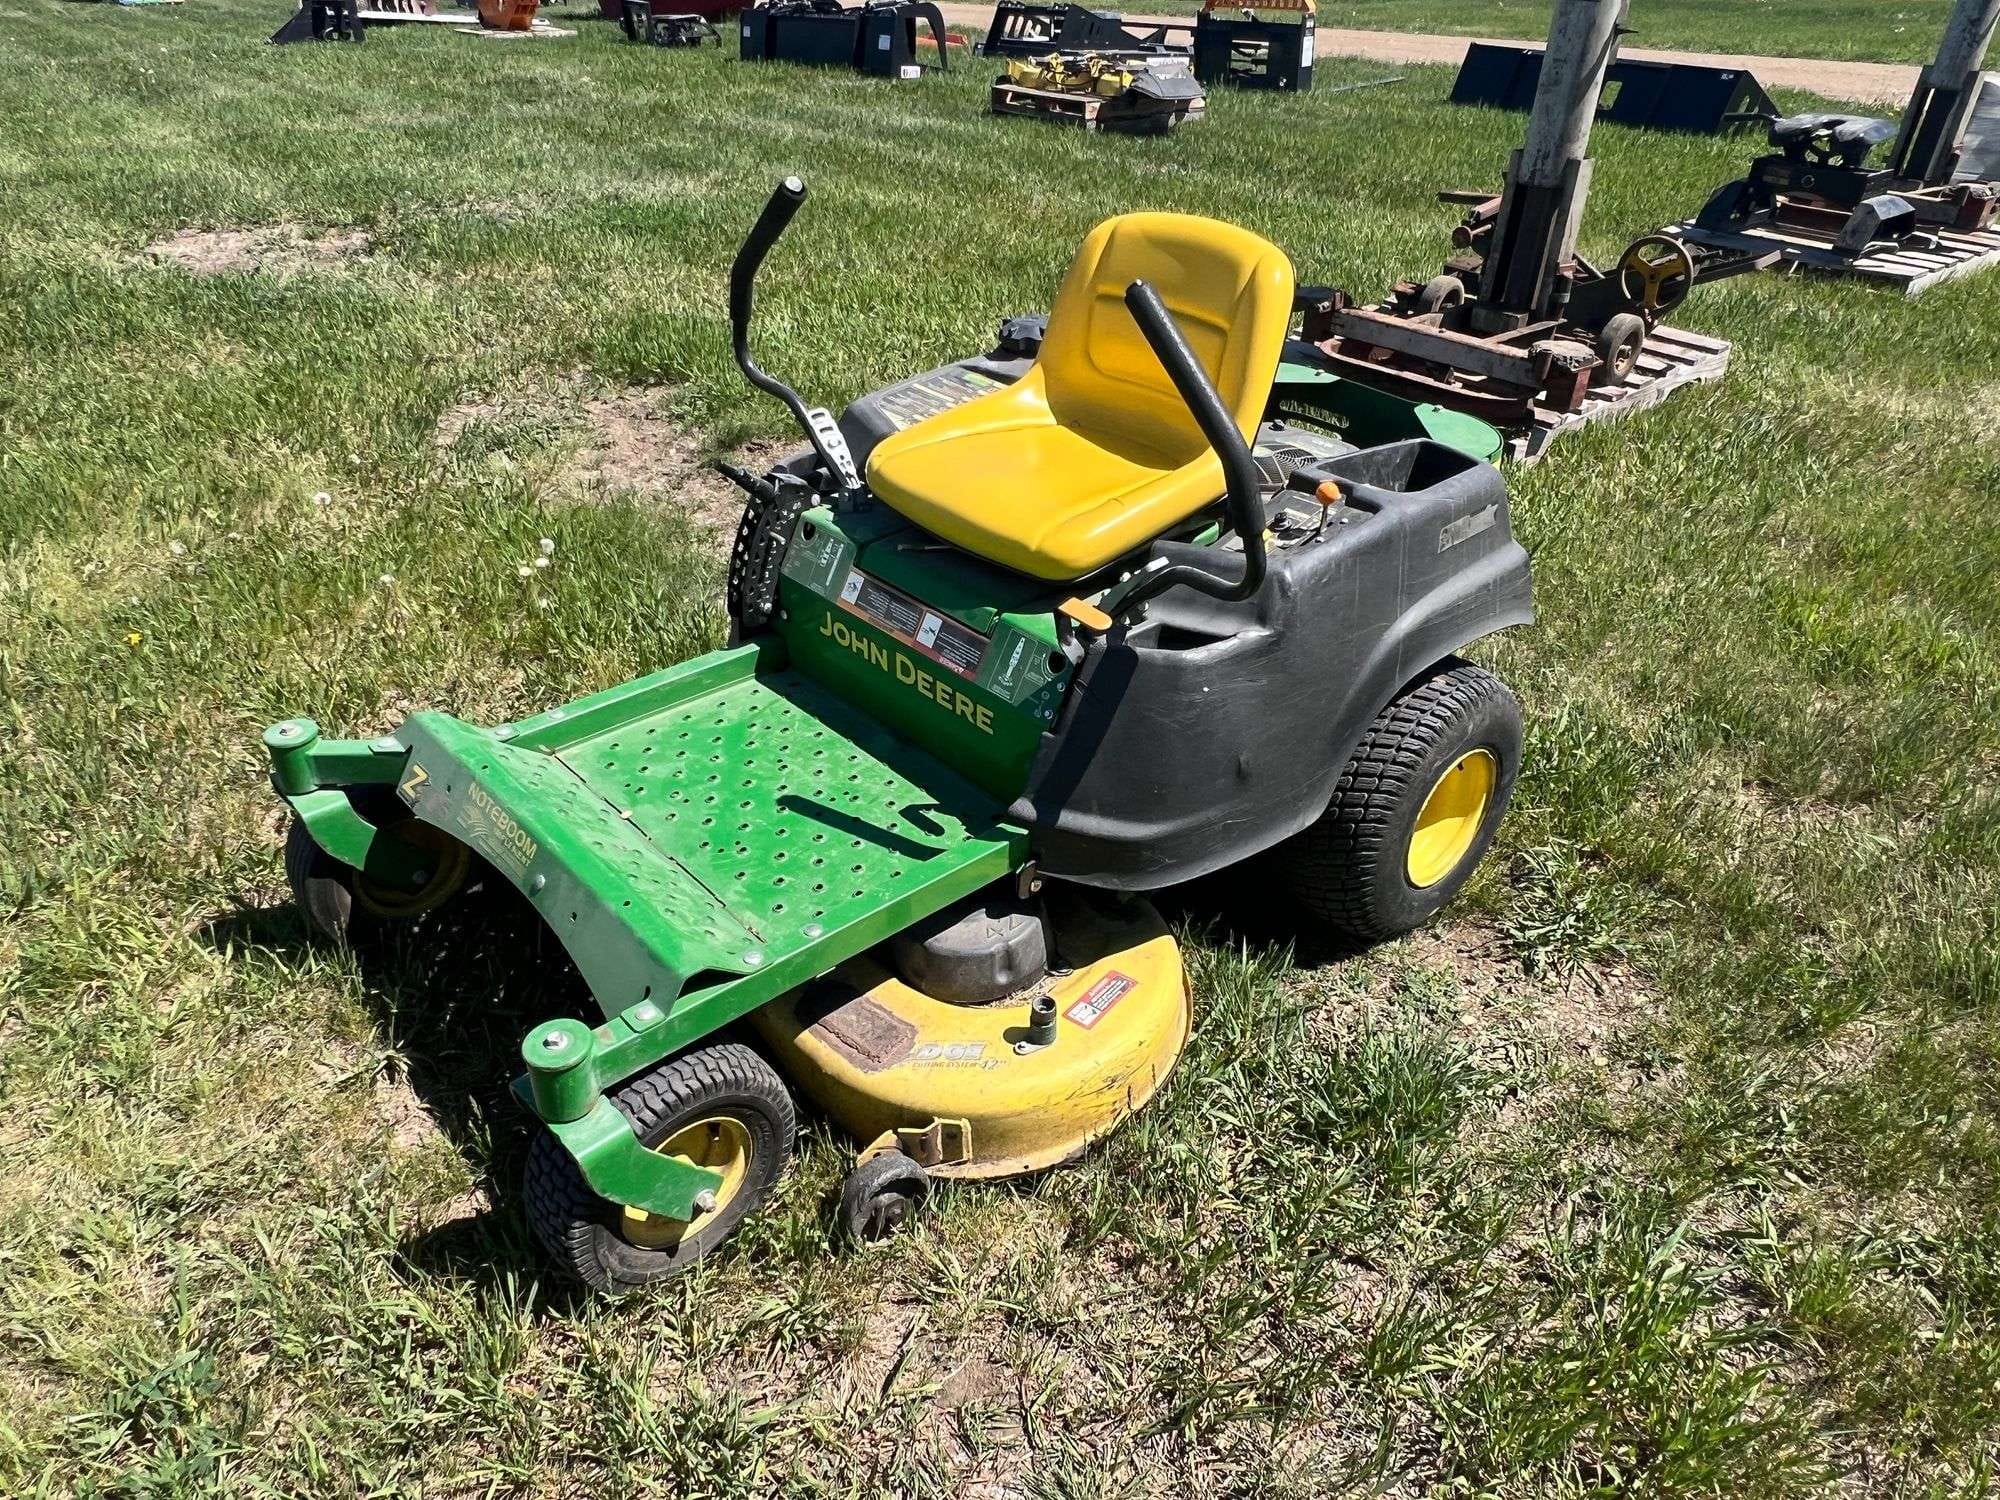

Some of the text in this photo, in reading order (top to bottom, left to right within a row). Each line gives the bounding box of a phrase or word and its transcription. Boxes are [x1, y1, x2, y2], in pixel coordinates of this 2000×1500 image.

[819, 611, 889, 672] JOHN
[895, 652, 995, 735] DEERE
[468, 782, 538, 860] NOTEBOOM
[911, 1040, 986, 1061] DGE
